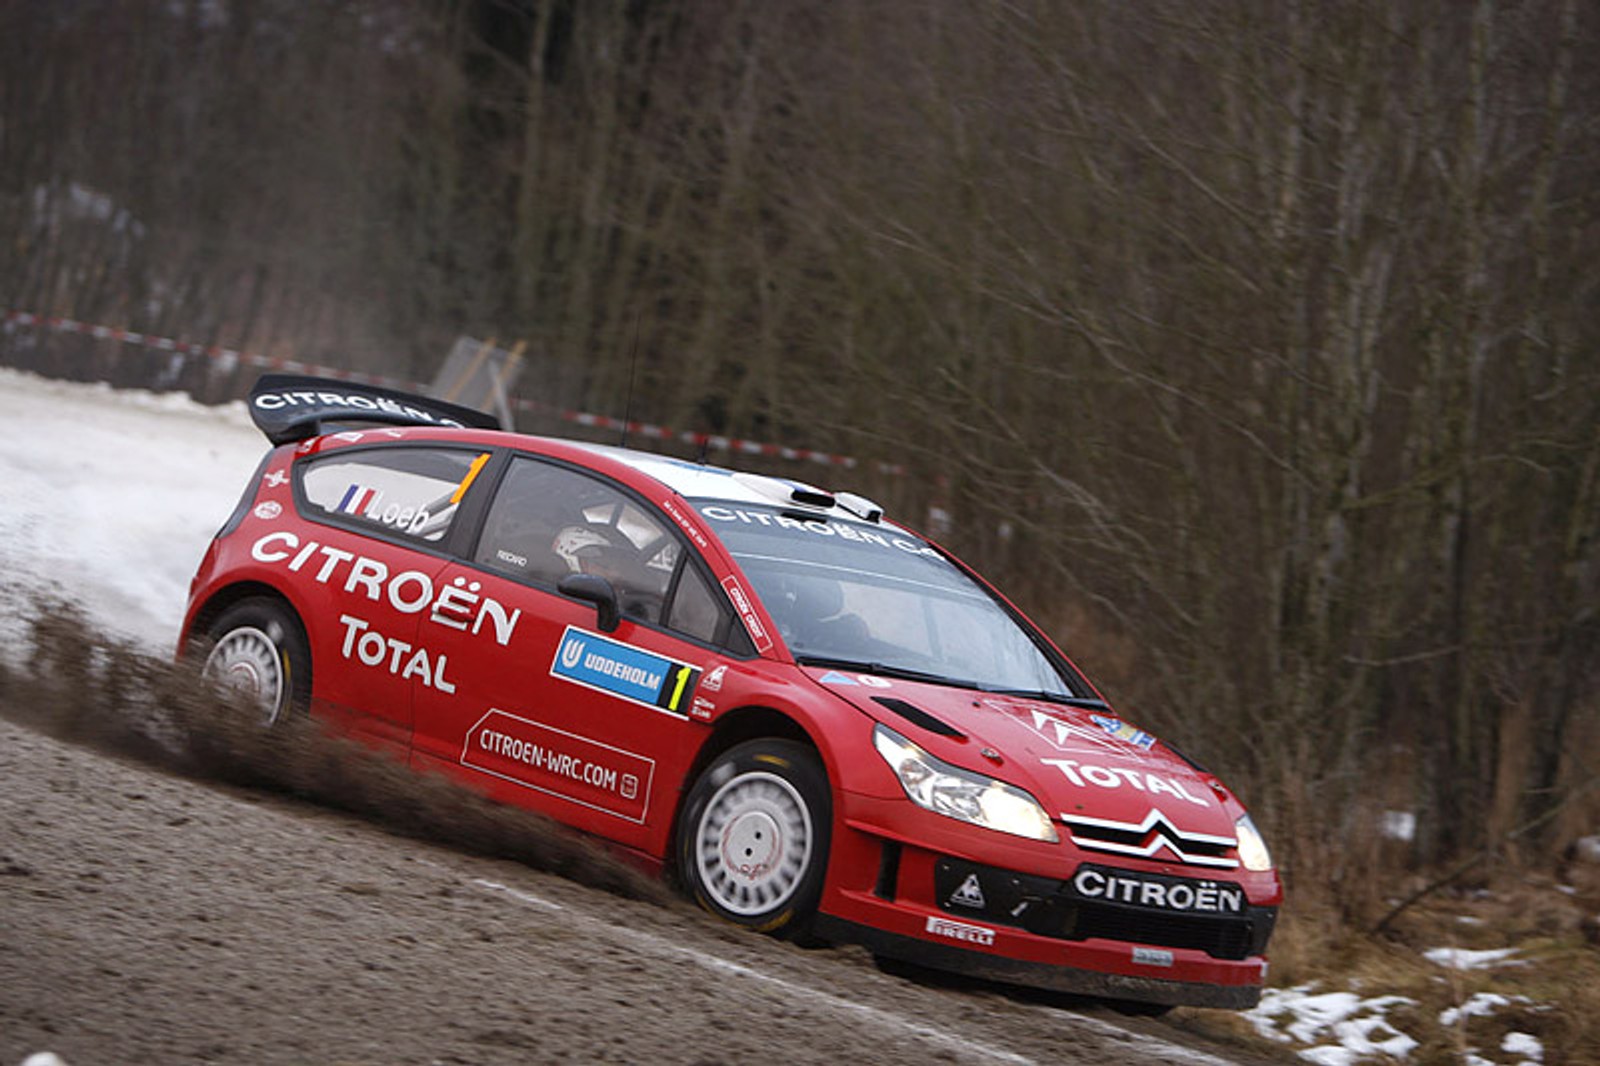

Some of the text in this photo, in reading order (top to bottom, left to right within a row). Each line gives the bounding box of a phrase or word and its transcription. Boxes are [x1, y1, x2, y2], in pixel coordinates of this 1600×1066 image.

[366, 491, 430, 534] Loeb
[251, 531, 521, 646] CITROËN
[340, 614, 456, 695] TOTAL
[583, 652, 662, 690] UDDEHOLM
[667, 666, 692, 711] 1
[479, 728, 617, 792] CITROEN-WRC.COM
[1039, 757, 1209, 807] TOTAL
[1073, 870, 1242, 913] CITROËN
[926, 915, 996, 946] PIRELLI
